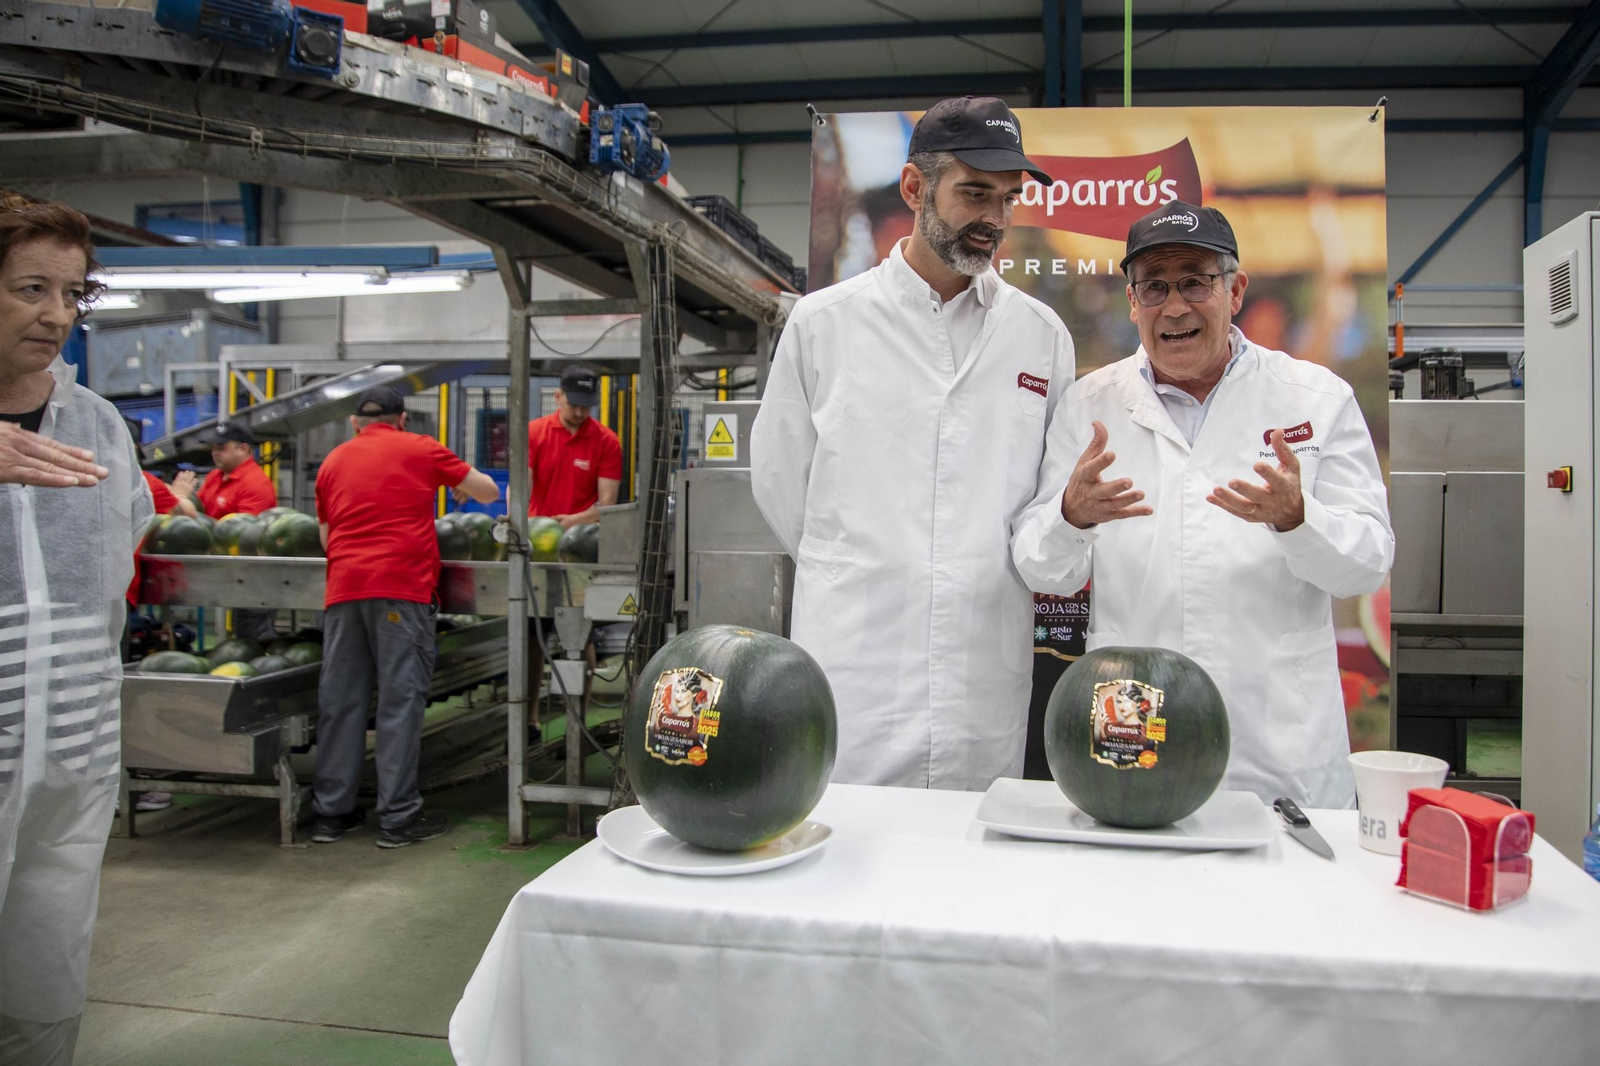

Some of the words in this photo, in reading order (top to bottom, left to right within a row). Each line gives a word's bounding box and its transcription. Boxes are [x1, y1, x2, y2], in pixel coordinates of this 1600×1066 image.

[1013, 165, 1178, 216] aparrós
[1152, 215, 1193, 226] CAPARRÓS
[1000, 259, 1113, 275] PREMI
[697, 724, 718, 737] 2025
[1146, 731, 1166, 740] 2025
[1360, 814, 1386, 839] era
